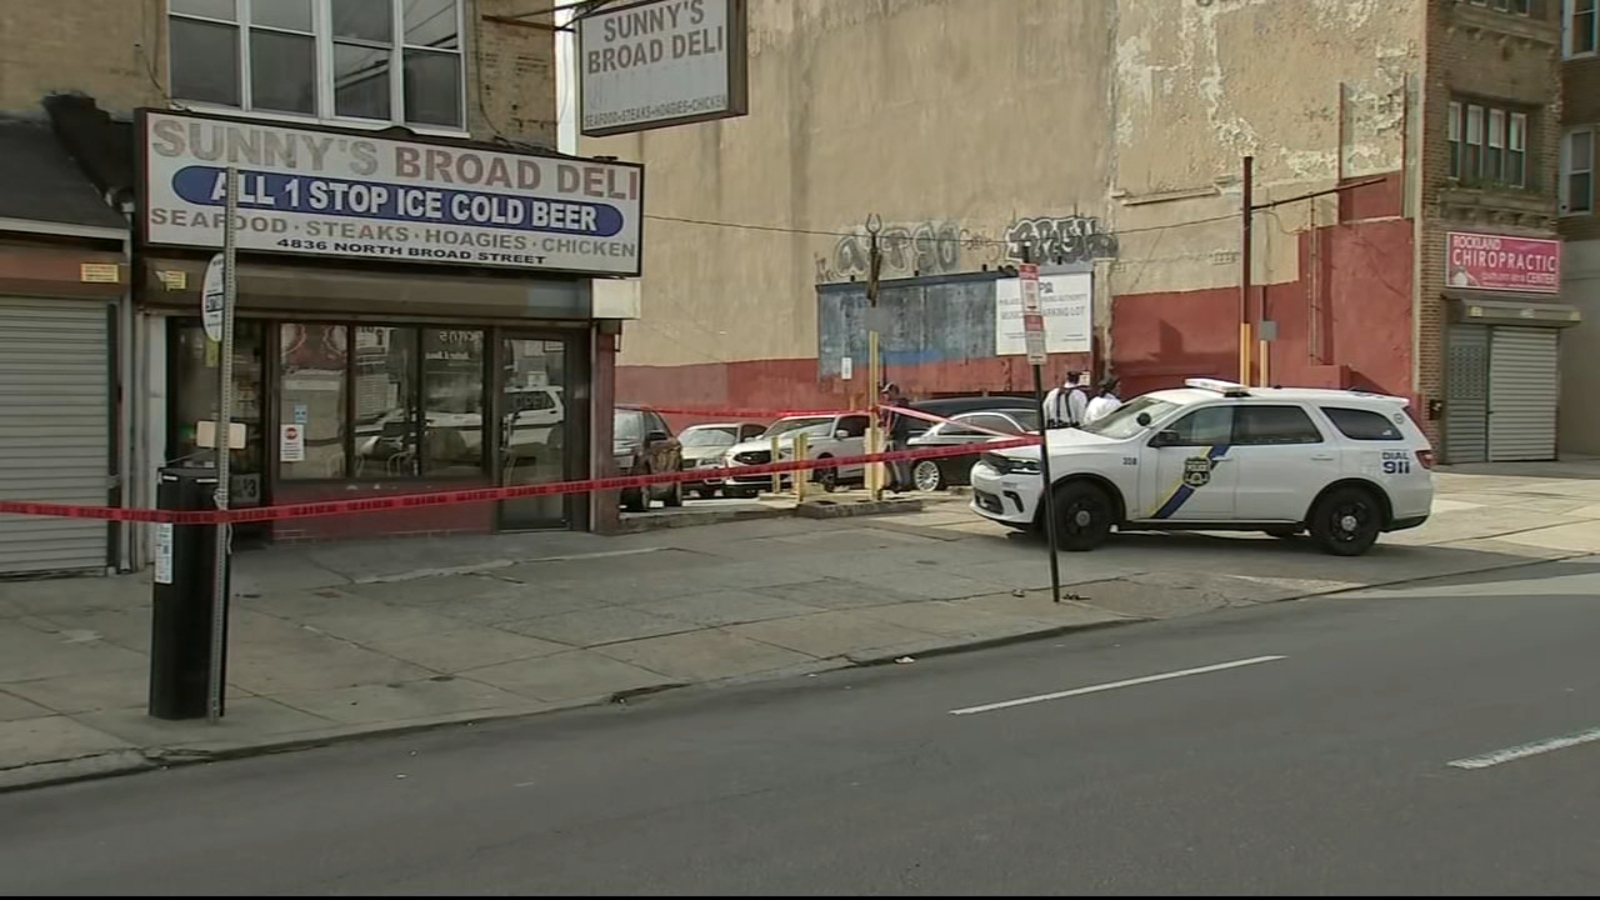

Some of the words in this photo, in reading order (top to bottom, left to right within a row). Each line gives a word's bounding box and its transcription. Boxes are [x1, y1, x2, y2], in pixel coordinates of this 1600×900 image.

[604, 0, 705, 43] SUNNY'S
[588, 39, 663, 74] BROAD
[672, 26, 723, 59] DELI
[152, 119, 379, 176] SUNNY'S
[396, 146, 541, 190] BROAD
[557, 164, 637, 200] DELI
[211, 172, 275, 205] ALL
[285, 178, 299, 207] 1
[309, 181, 388, 214] STOP
[397, 188, 442, 219] ICE
[451, 193, 524, 225] COLD
[532, 200, 597, 232] BEER
[151, 208, 287, 233] SEAFOOD
[306, 220, 408, 243] STEAKS
[425, 228, 526, 251] HOAGIES
[541, 236, 636, 258] CHICKEN
[1452, 235, 1502, 251] ROCKLAND
[277, 238, 328, 251] 4836
[334, 242, 402, 256] NORTH
[408, 247, 472, 260] BROAD
[478, 252, 547, 265] STREET
[1452, 249, 1556, 272] CHIROPRACTIC
[1381, 451, 1410, 460] DIAL
[1383, 461, 1410, 474] 911
